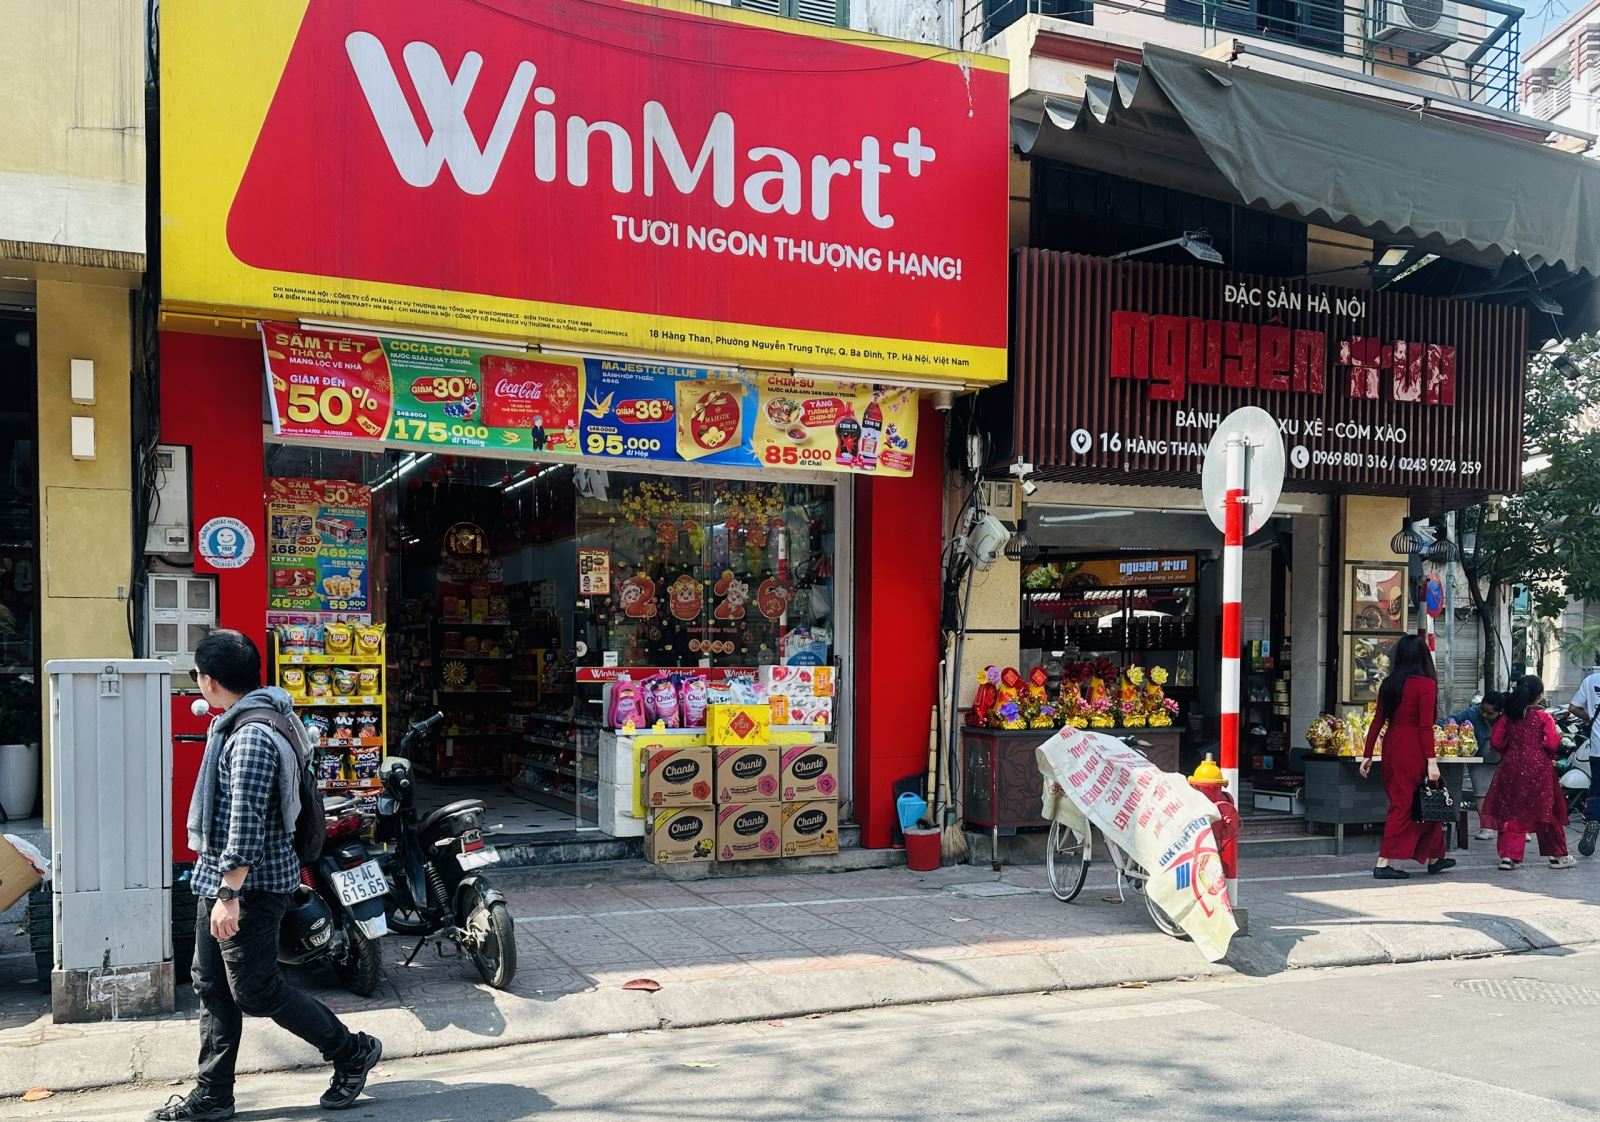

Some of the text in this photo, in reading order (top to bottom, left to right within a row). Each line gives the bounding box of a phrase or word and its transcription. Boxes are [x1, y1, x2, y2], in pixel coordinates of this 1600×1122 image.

[345, 31, 936, 229] WinMart+
[611, 215, 962, 281] TƯƠI NGON THƯỢNG HẠNG!
[318, 290, 329, 298] NỘI
[334, 292, 350, 300] CÔNG
[1224, 282, 1366, 323] ĐẶC SẢN HÀ NỘI
[410, 308, 430, 316] NHÁNH
[455, 312, 472, 320] CÔNG
[275, 332, 366, 353] SẮM TẾT
[390, 341, 470, 358] COCA-COLA
[649, 329, 970, 366] 18 Hàng Than, Phường Nguyễn Trung Trực, Q. Ba Đình, TP. Hà Nội, Việt Nam
[289, 357, 362, 370] MANG LỘC VỀ NHÀ
[316, 351, 333, 360] GA
[602, 361, 697, 378] MAJESTIC BLUE
[290, 374, 346, 388] GIẢM ĐẾN
[432, 377, 478, 398] 30%
[494, 378, 543, 399] Coca-Cola
[768, 376, 814, 388] CHIN-SU
[287, 384, 378, 425] 50%
[635, 400, 674, 420] 36%
[810, 400, 833, 408] TẶNG
[394, 418, 489, 442] 175.000
[1175, 407, 1220, 429] BÁNH
[1278, 417, 1300, 436] XU
[1303, 417, 1323, 437] XÊ
[1374, 424, 1406, 443] XÀO
[586, 434, 661, 455] 95.000
[1099, 431, 1208, 457] 16 HÀNG THAN
[765, 445, 832, 466] 85.000
[1312, 450, 1342, 466] 0969
[1343, 451, 1363, 467] 801
[1399, 456, 1427, 472] 0243
[1430, 458, 1456, 473] 9274
[1460, 460, 1482, 475] 259
[324, 488, 358, 504] 50%
[272, 502, 296, 510] PEPSI
[328, 508, 366, 516] HEINEKEN
[665, 762, 696, 776] Chanté
[735, 758, 762, 771] Chanté
[795, 758, 824, 772] Chanté
[671, 820, 699, 834] Chanté
[736, 814, 765, 828] Chanté
[796, 814, 824, 827] Chanté
[1113, 810, 1131, 831] KẾT
[339, 864, 376, 888] 29-AC
[341, 878, 386, 905] 615.65
